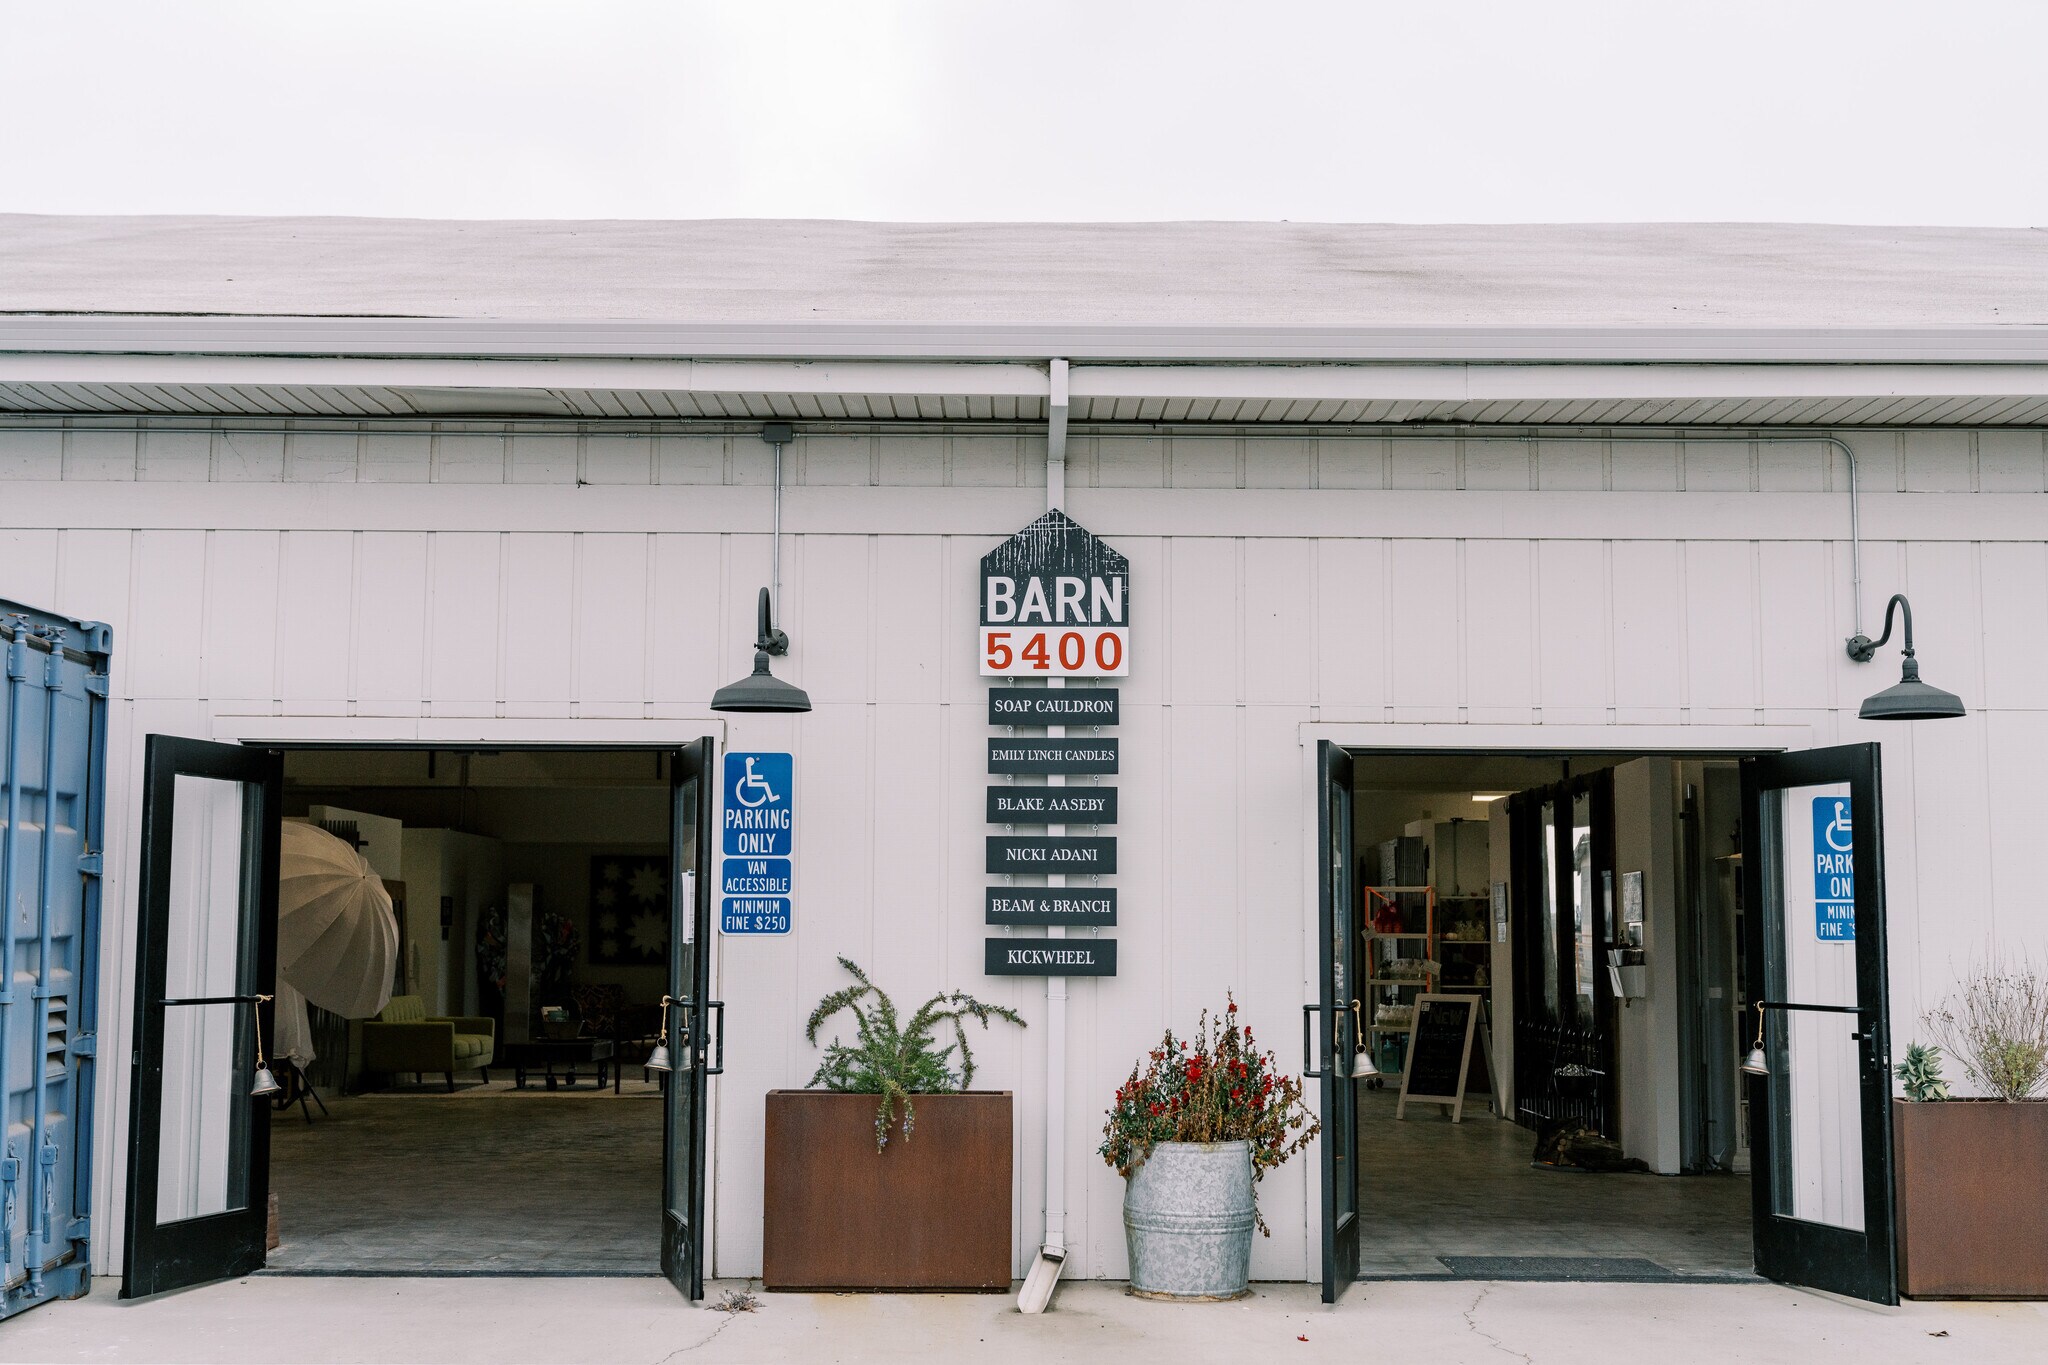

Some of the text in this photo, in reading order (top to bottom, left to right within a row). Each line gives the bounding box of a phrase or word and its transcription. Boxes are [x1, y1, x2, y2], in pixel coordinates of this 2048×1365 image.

[987, 576, 1123, 623] BARN
[987, 632, 1123, 670] 5400
[994, 699, 1114, 713] SOAP CAULDRON
[991, 749, 1115, 762] EMILY LYNCH CANDLES
[997, 797, 1105, 811] BLAKE AASEBY
[725, 809, 790, 829] PARKING
[738, 832, 776, 854] ONLY
[1006, 848, 1098, 861] NICKI ADANI
[747, 861, 767, 875] VAN
[1817, 854, 1853, 874] PARK
[725, 877, 788, 892] ACCESSIBLE
[1830, 877, 1851, 897] ON
[733, 900, 780, 914] MINIMUM
[991, 898, 1111, 913] BEAM & BRANCH
[726, 915, 786, 931] FINE $250
[1820, 922, 1843, 937] FINE
[1007, 949, 1096, 965] KICKWHEEL
